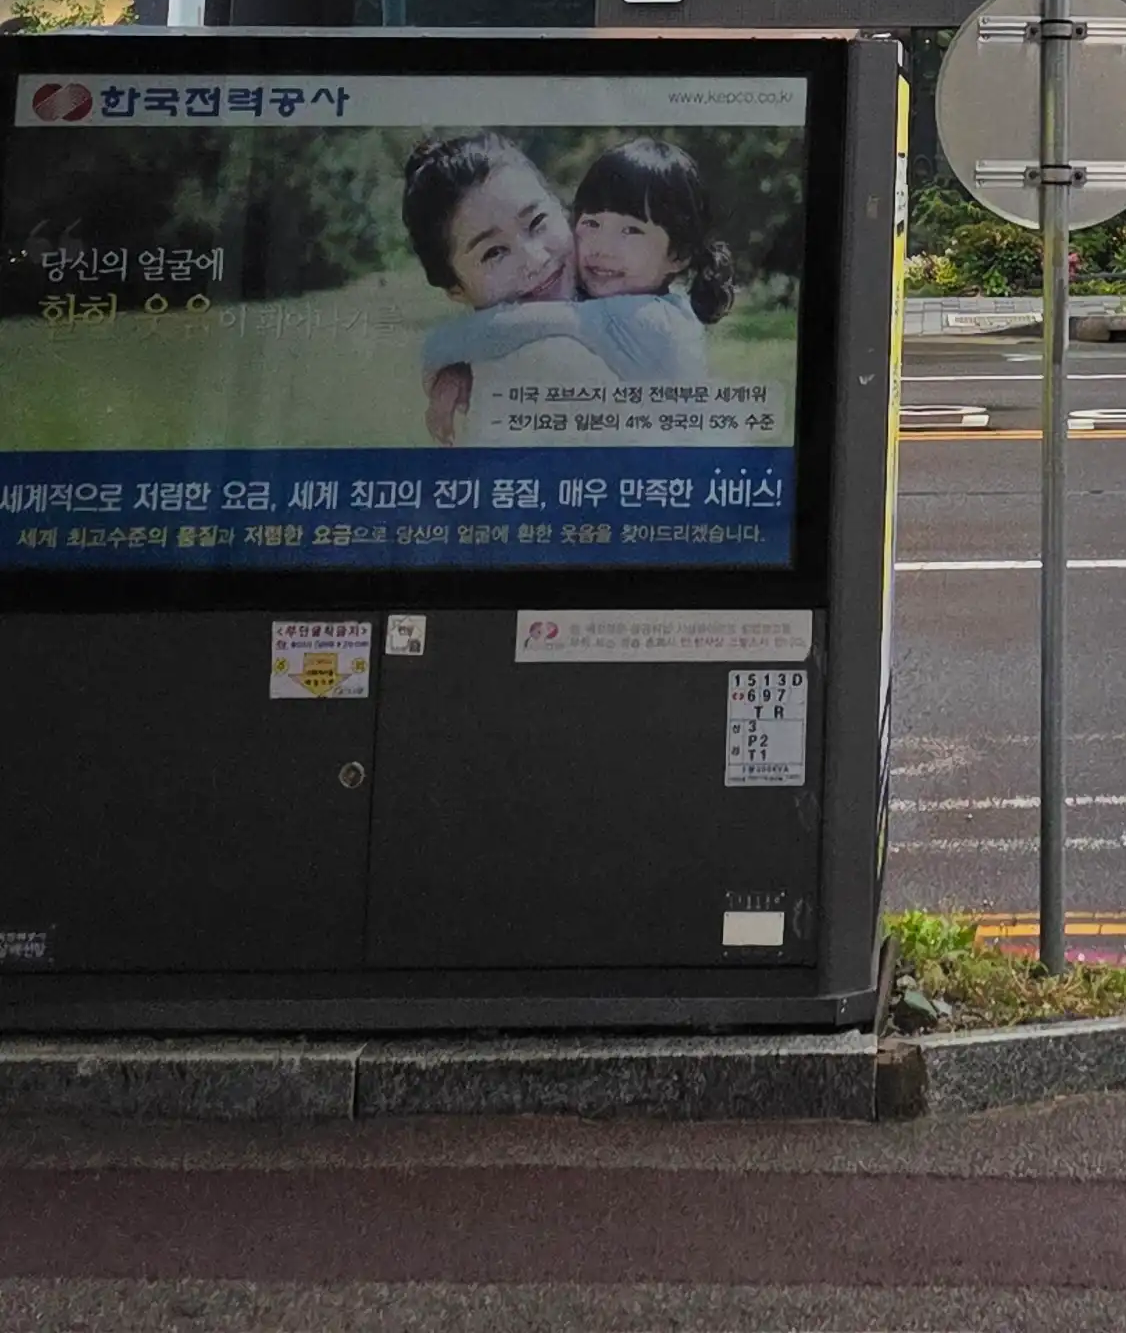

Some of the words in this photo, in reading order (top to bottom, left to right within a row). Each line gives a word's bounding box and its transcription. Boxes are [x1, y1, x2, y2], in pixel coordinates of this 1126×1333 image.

[99, 86, 350, 118] 한국전력공사
[41, 247, 128, 283] 당신의
[138, 247, 224, 282] 얼굴에
[509, 386, 540, 404] 미국
[545, 386, 607, 403] 포브스지
[612, 386, 643, 404] 선정
[649, 386, 710, 404] 전력부문
[715, 386, 768, 403] 세계1위
[508, 414, 568, 432] 전기요금
[574, 414, 620, 432] 일본의
[625, 415, 653, 430] 41%
[659, 414, 703, 431] 영국의
[708, 414, 738, 430] 53%
[744, 414, 776, 431] 수준
[0, 482, 123, 513] 세계적으로
[133, 481, 211, 512] 저렴한
[221, 480, 277, 513] 요금,
[287, 480, 339, 511] 세계
[349, 479, 422, 510] 최고의
[432, 479, 480, 509] 전기
[490, 478, 547, 511] 품질,
[558, 478, 608, 508] 매우
[618, 477, 693, 508] 만족한
[704, 476, 783, 508] 서비스!
[17, 527, 58, 549] 세계
[67, 526, 168, 549] 최고수준의
[176, 524, 236, 548] 품질과
[243, 524, 304, 547] 저렴한
[311, 524, 388, 547] 요금으로
[396, 524, 450, 546] 당신의
[457, 524, 509, 544] 얼굴에
[517, 524, 553, 544] 환한
[560, 523, 613, 544] 웃음을
[748, 719, 757, 733] 3
[748, 734, 769, 748] P2
[748, 748, 767, 762] T1
